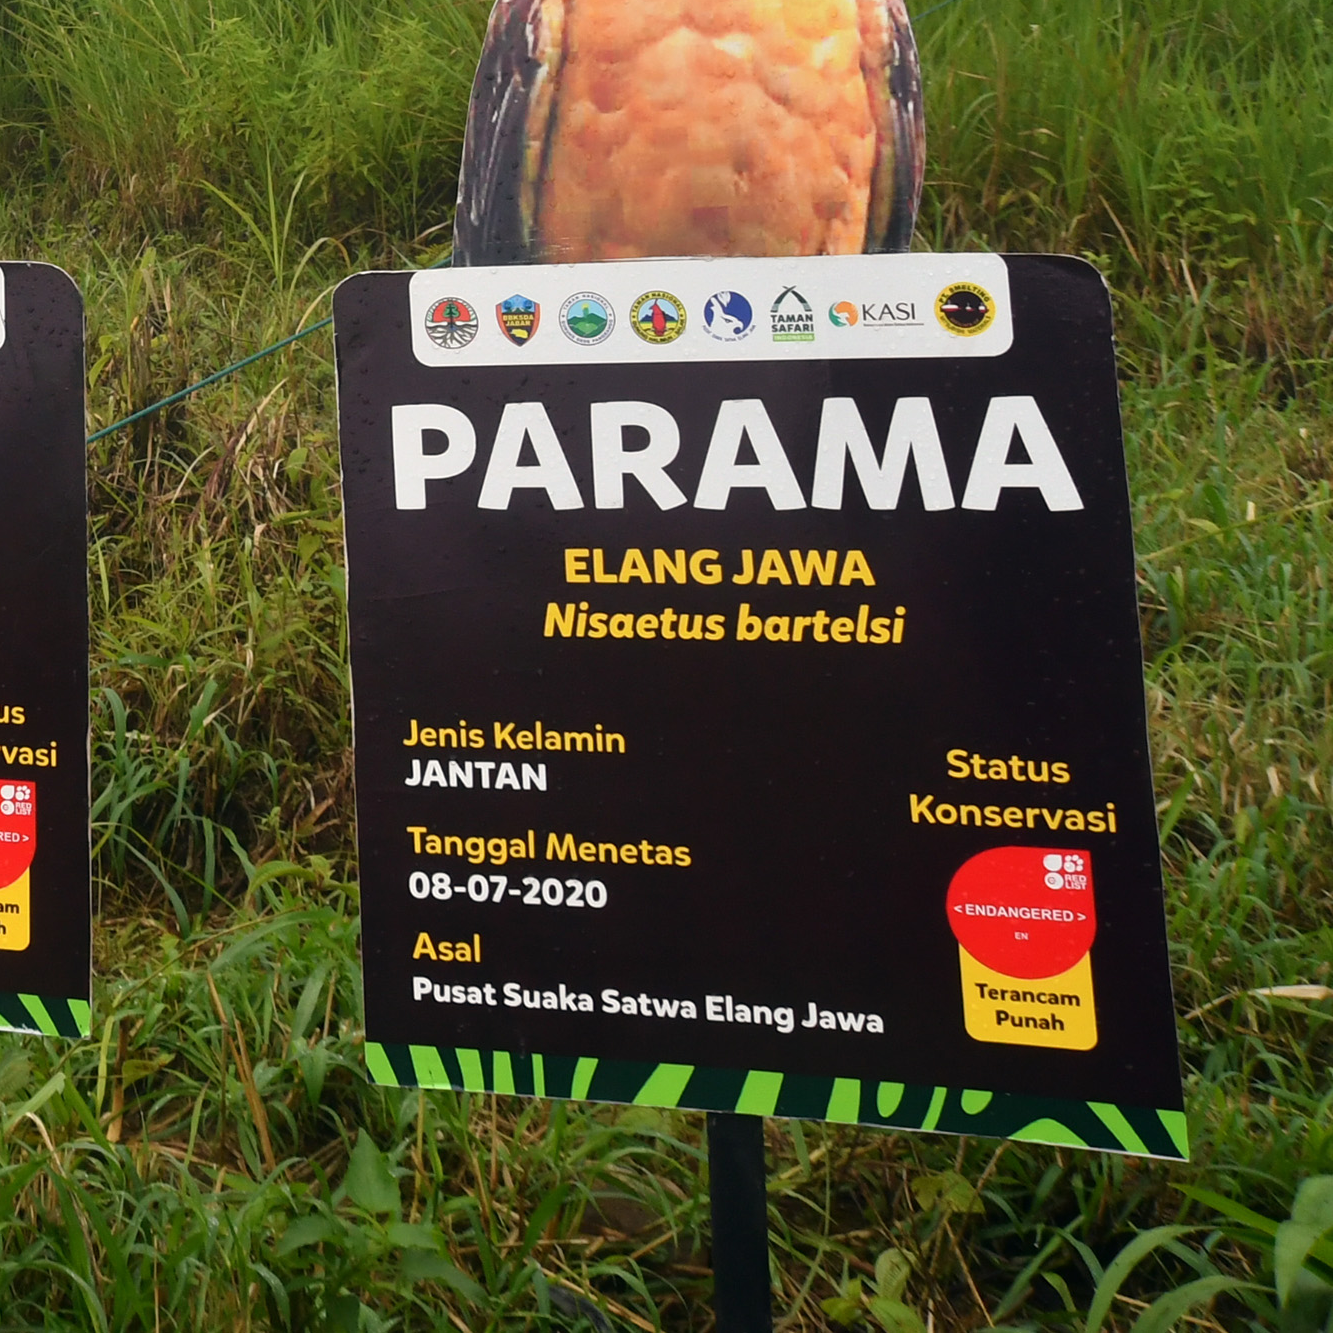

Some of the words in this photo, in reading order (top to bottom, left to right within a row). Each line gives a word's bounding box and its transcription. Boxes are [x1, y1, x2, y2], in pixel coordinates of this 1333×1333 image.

[632, 295, 650, 312] TAMAN
[950, 284, 991, 303] SMELTING
[770, 314, 813, 323] TAMAN
[862, 302, 916, 321] KASI
[771, 324, 814, 333] SAFARI
[392, 396, 1084, 511] PARAMA
[565, 549, 722, 584] ELANG
[732, 549, 875, 586] JAWA
[544, 602, 725, 640] Nisaetus
[736, 603, 906, 644] bartelsi
[403, 720, 484, 748] Jenis
[494, 721, 625, 753] Kelamin
[405, 759, 546, 791] JANTAN
[947, 749, 1070, 783] Status
[15, 801, 32, 809] RED
[15, 808, 32, 816] LIST
[910, 794, 1116, 832] Konservasi
[407, 827, 535, 865] Tanggal
[546, 833, 691, 866] Menetas
[1064, 874, 1087, 883] RED
[1064, 881, 1087, 890] LIST
[409, 872, 607, 908] 08-07-2020
[965, 903, 1074, 922] ENDANGERED
[1014, 932, 1029, 940] EN
[413, 933, 480, 962] Asal
[413, 977, 497, 1005] Pusat
[503, 983, 593, 1011] Suaka
[602, 989, 696, 1018] Satwa
[706, 996, 794, 1033] Elang
[802, 1003, 883, 1033] Jawa
[974, 983, 1081, 1007] Terancam
[995, 1010, 1065, 1031] Punah
